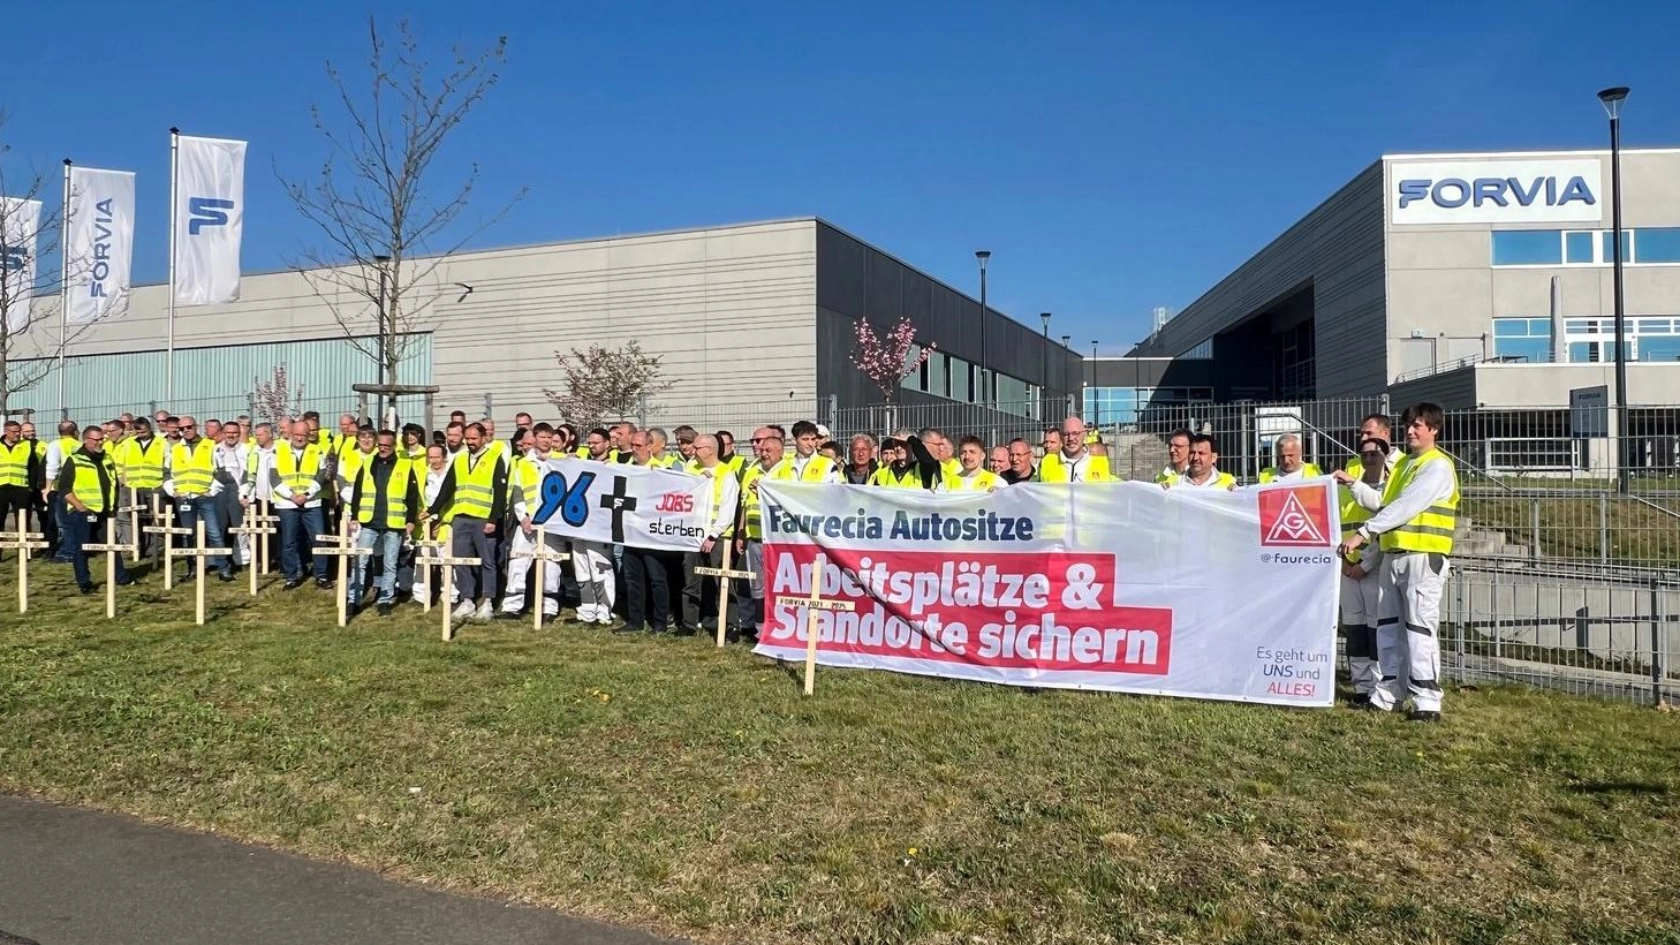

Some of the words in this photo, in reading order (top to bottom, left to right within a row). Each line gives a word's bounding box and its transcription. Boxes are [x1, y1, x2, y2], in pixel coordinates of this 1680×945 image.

[1399, 176, 1596, 208] FORVIA
[91, 198, 112, 297] FORVIA
[531, 470, 597, 527] 96
[656, 493, 693, 513] JOBS
[649, 517, 705, 538] sterben
[769, 505, 883, 540] Faurecia
[890, 508, 1034, 541] Autositze
[773, 552, 1050, 615] Arbeitsplätze
[1061, 563, 1104, 610] &
[780, 597, 806, 607] FORVIA
[770, 602, 969, 655] Standorte
[977, 610, 1159, 665] sichern
[1256, 646, 1272, 660] Es
[1275, 648, 1305, 664] geht
[1308, 653, 1328, 663] um
[1263, 664, 1294, 678] UNS
[1296, 668, 1320, 680] und
[1267, 682, 1316, 697] ALLES!
